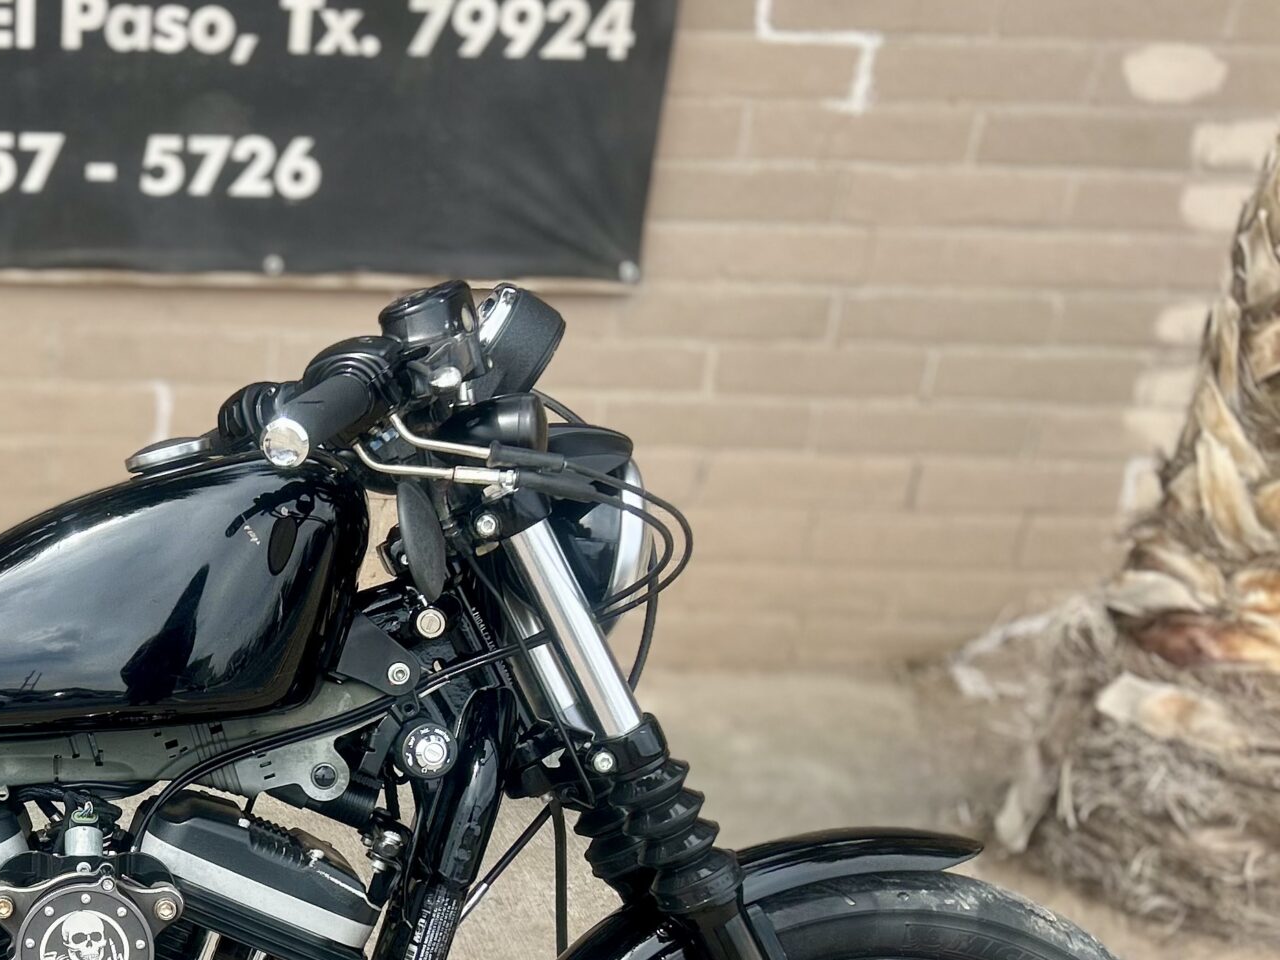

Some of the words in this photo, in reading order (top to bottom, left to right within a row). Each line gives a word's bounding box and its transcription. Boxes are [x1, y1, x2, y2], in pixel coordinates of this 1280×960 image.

[60, 0, 258, 65] Paso,
[278, 0, 381, 57] Tx.
[407, 0, 636, 61] 79924
[84, 161, 118, 183] -
[138, 134, 322, 200] 5726
